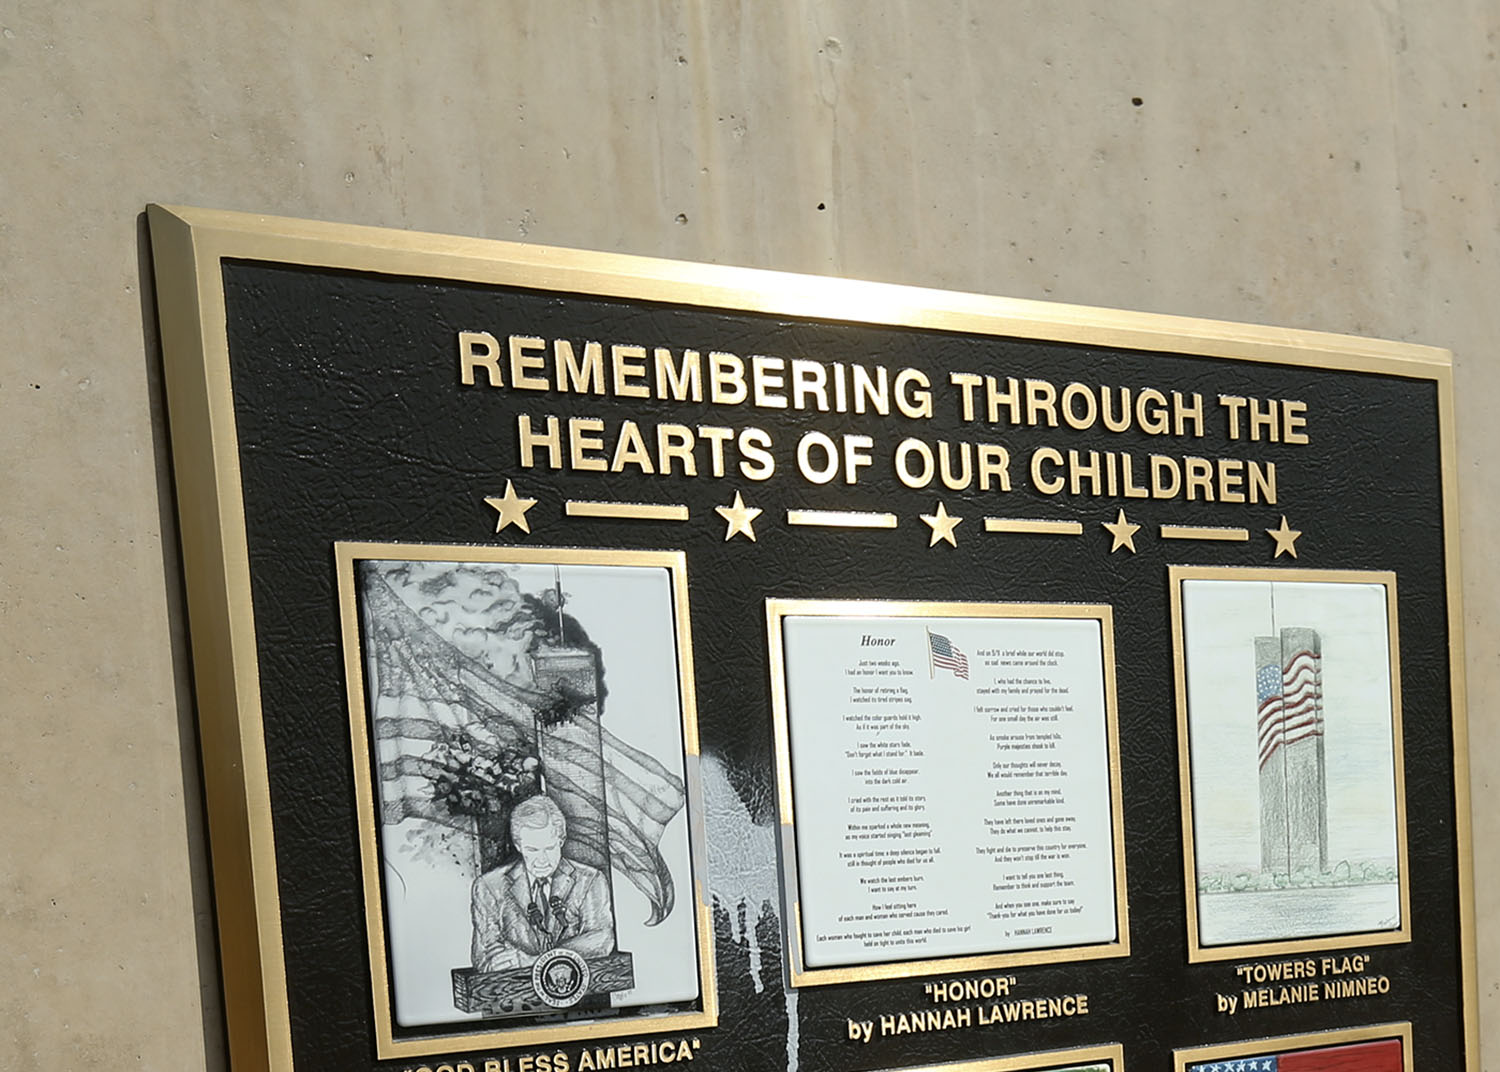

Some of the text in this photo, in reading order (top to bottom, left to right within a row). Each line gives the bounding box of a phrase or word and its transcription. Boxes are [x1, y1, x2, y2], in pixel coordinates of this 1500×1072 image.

[456, 331, 1310, 445] REMEMBERING THROUGH THE
[518, 414, 1279, 506] HEARTS OF OUR CHILDREN
[861, 636, 896, 646] Honor
[1236, 955, 1369, 986] "TOWERS FLAG"
[925, 977, 1017, 1004] "HONOR"
[1218, 977, 1390, 1014] by MELANIE NIMNEO
[848, 995, 1088, 1041] by HANNAH LAWRENCE
[578, 1039, 701, 1072] AMERICA"
